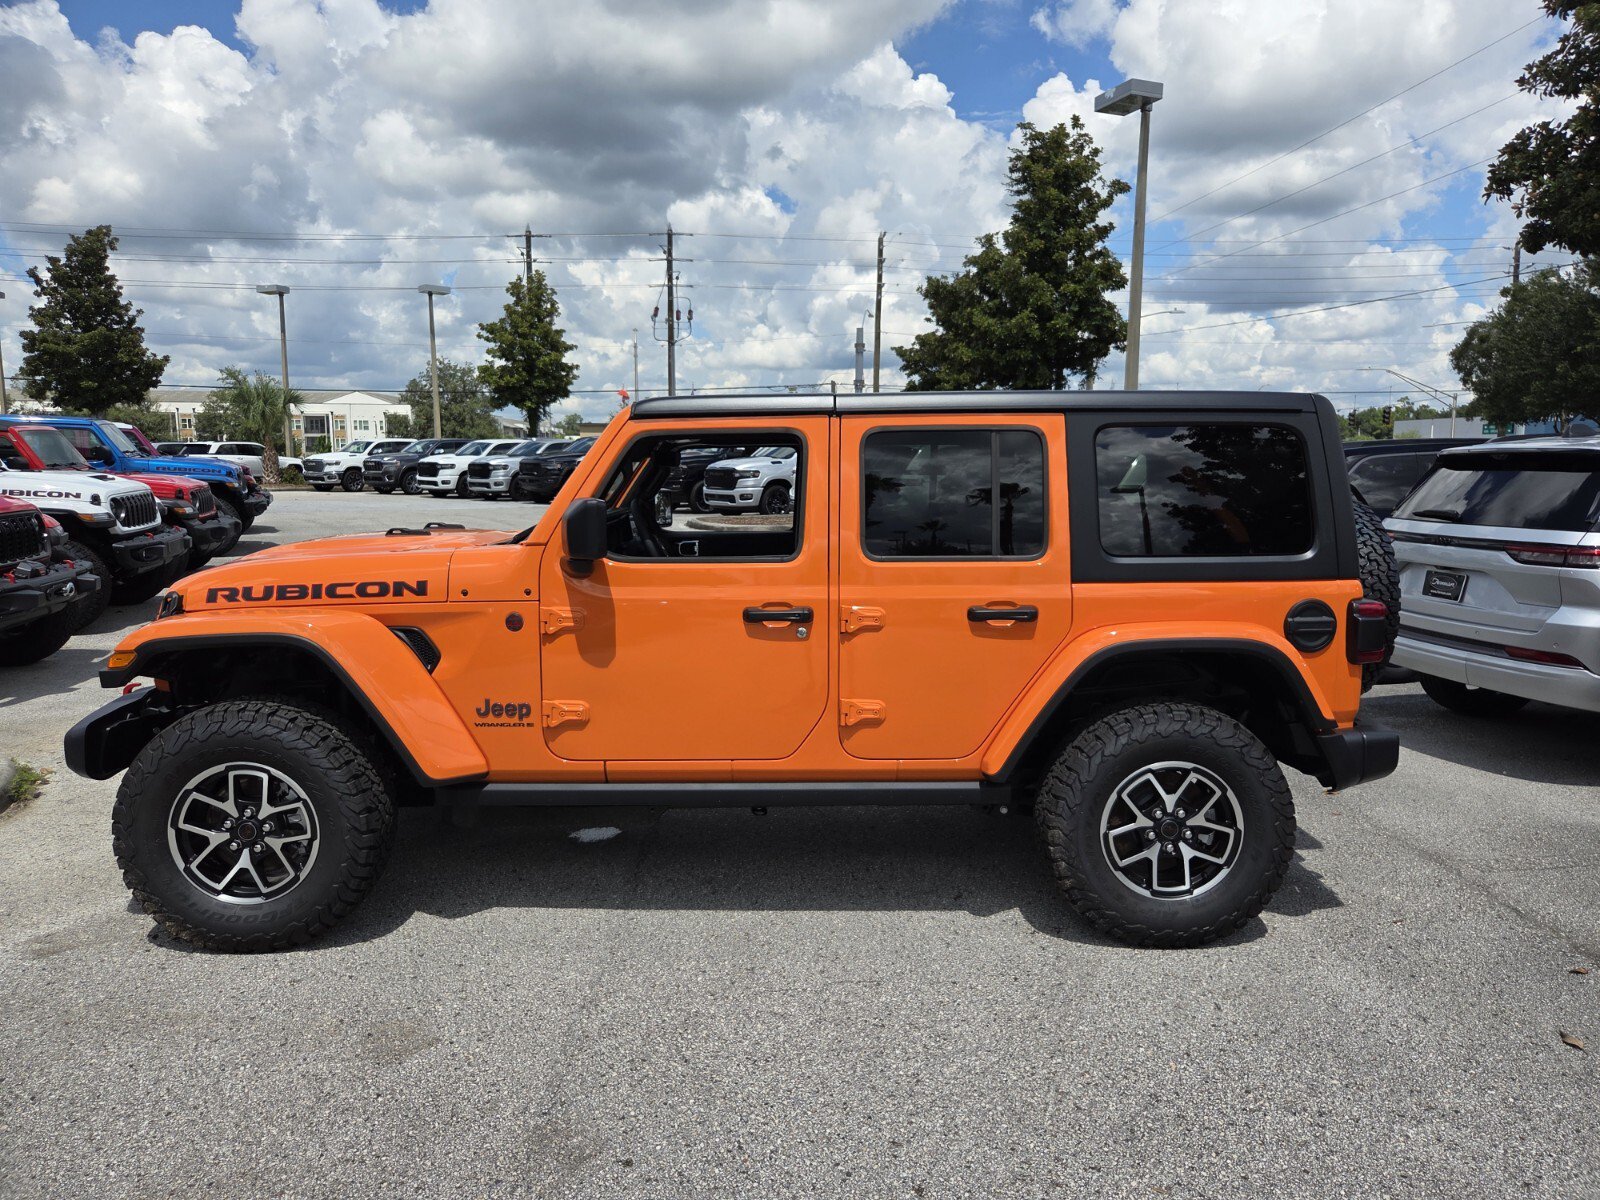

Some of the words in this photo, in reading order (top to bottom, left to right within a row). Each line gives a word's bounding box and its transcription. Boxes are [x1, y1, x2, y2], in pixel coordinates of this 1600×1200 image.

[155, 466, 222, 474] RUBICON
[2, 489, 82, 499] BICON
[205, 580, 428, 603] RUBICON
[476, 698, 532, 721] Jeep
